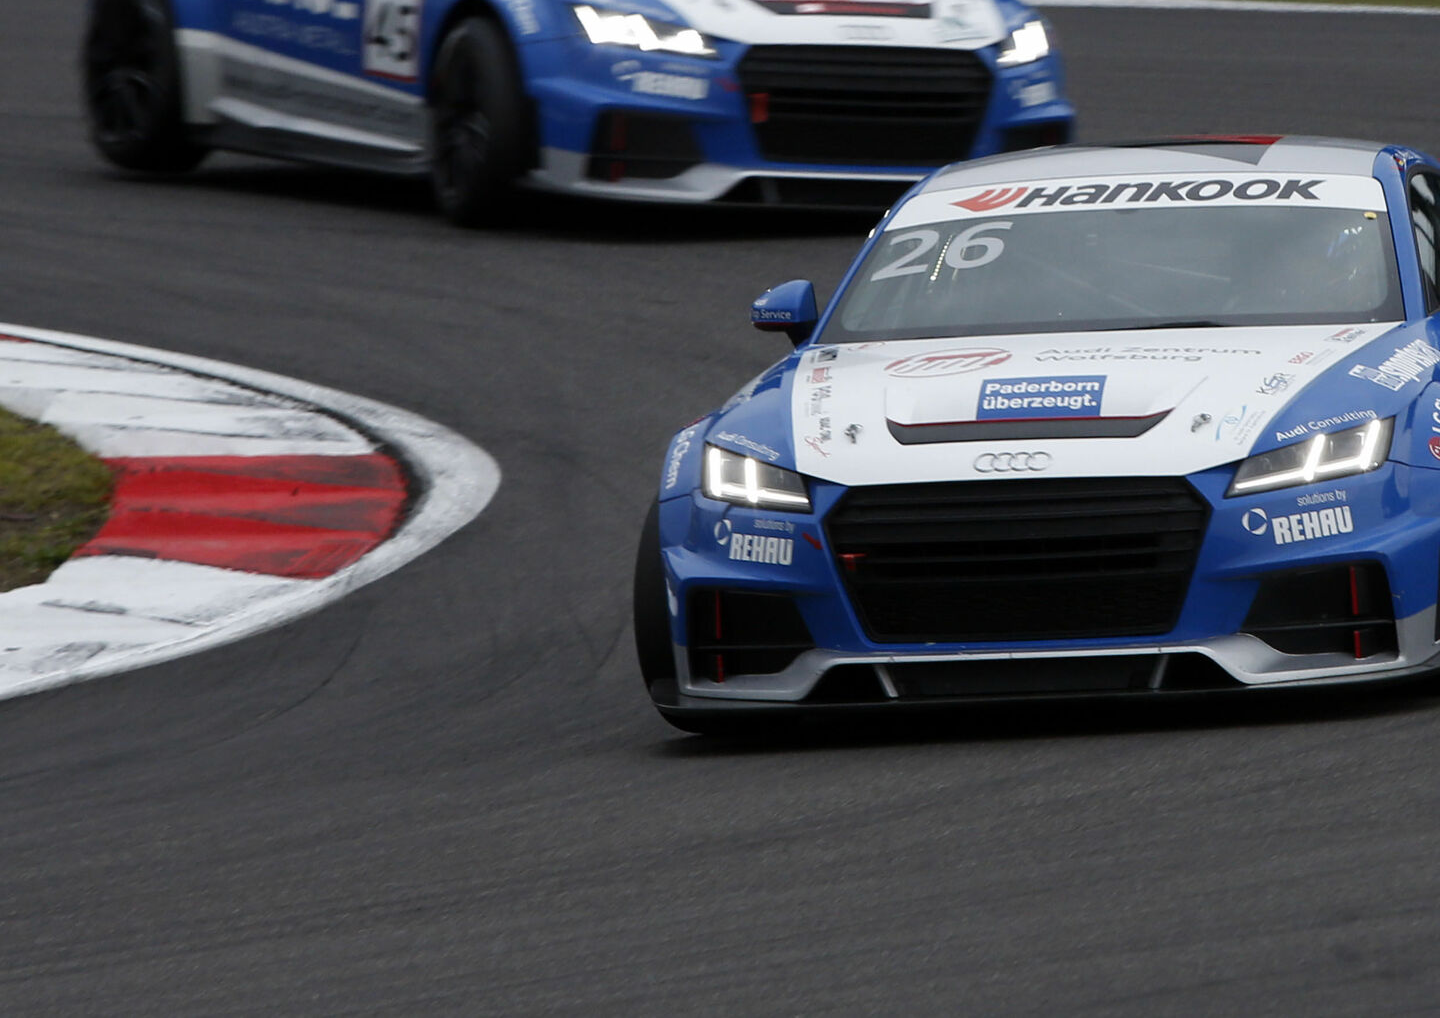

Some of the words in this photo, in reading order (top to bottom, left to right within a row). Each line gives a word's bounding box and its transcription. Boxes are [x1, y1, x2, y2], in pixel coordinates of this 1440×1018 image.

[871, 221, 1014, 282] 26
[1034, 354, 1203, 362] Wolfsburg
[1036, 346, 1112, 355] Audi
[1121, 346, 1262, 355] Zentrum
[984, 380, 1100, 395] Paderborn
[982, 393, 1098, 410] überzeugt.
[1276, 424, 1308, 442] Audi
[1307, 408, 1379, 431] Consulting
[1296, 491, 1335, 507] solutions
[1334, 489, 1347, 502] by
[1271, 505, 1354, 545] REHAU
[729, 532, 795, 566] REHAU
